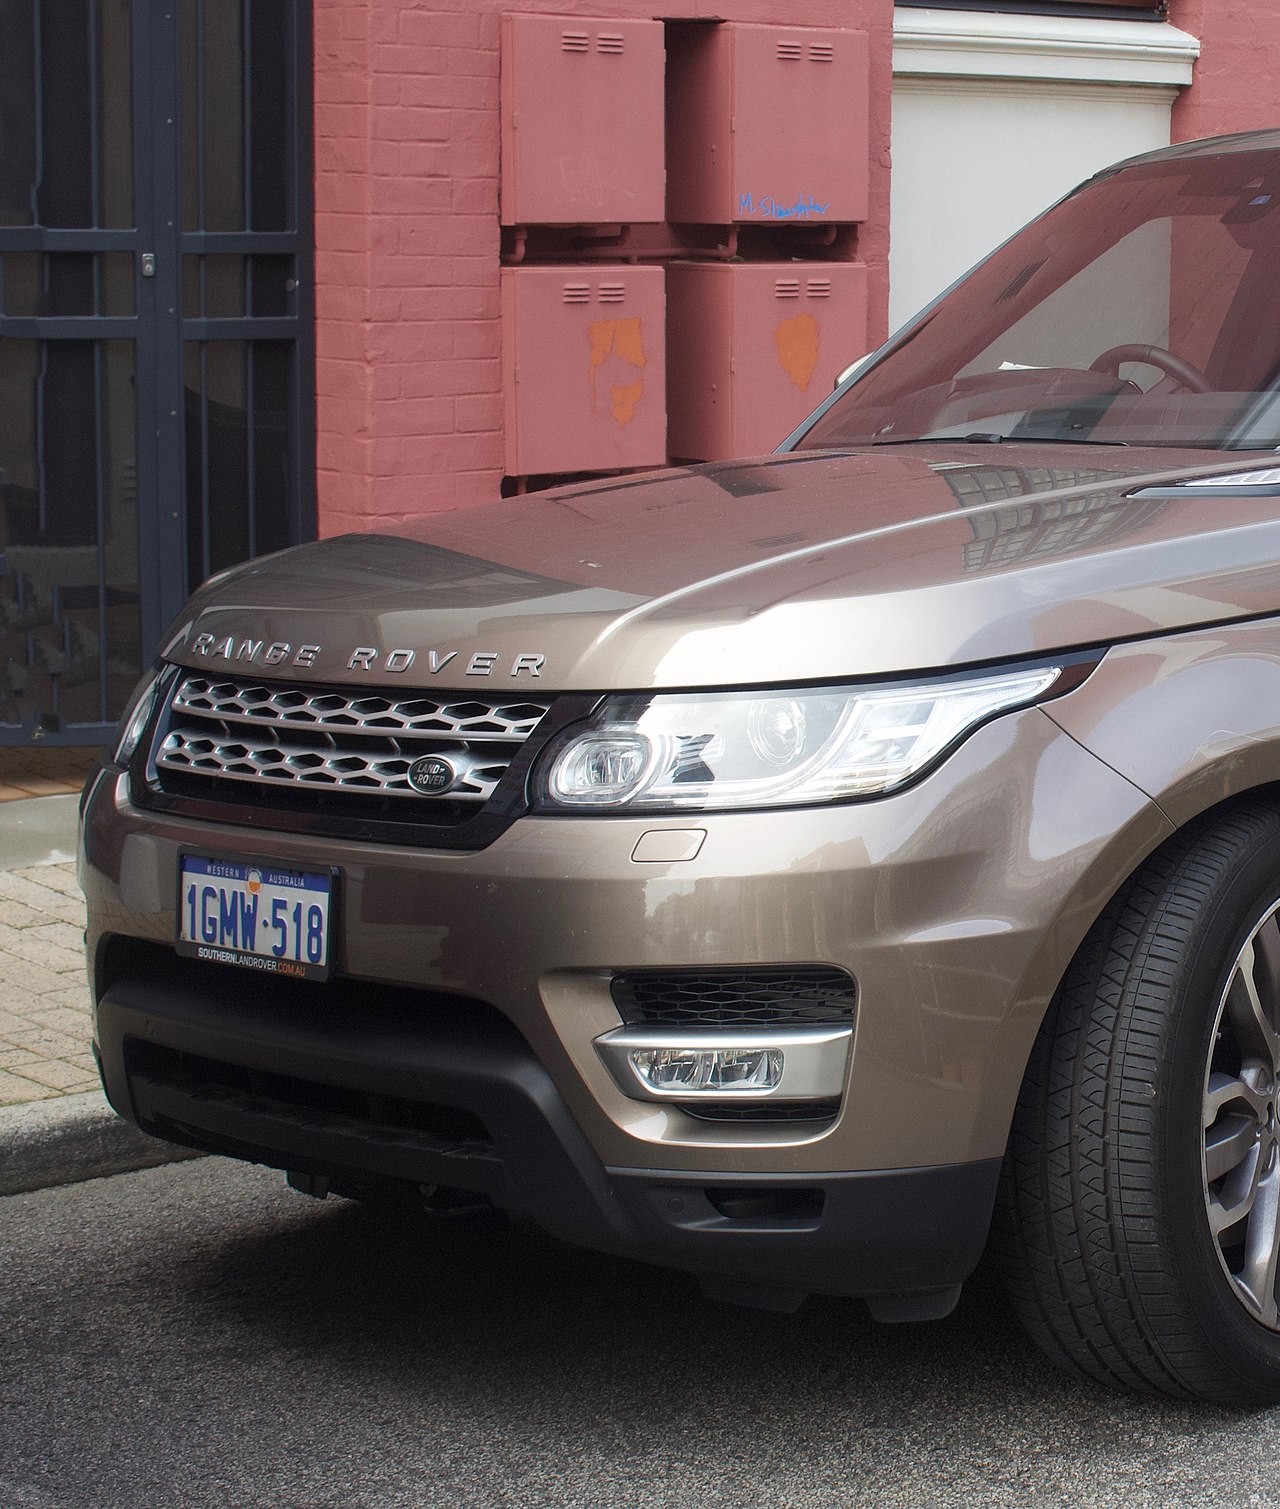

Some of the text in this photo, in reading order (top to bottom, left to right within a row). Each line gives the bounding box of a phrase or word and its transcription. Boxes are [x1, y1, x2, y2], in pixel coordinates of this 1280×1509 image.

[192, 633, 546, 677] RANGE ROVER
[417, 763, 441, 774] LAND
[416, 774, 446, 786] ROVER
[206, 865, 305, 888] WESTERN AUSTRALIA
